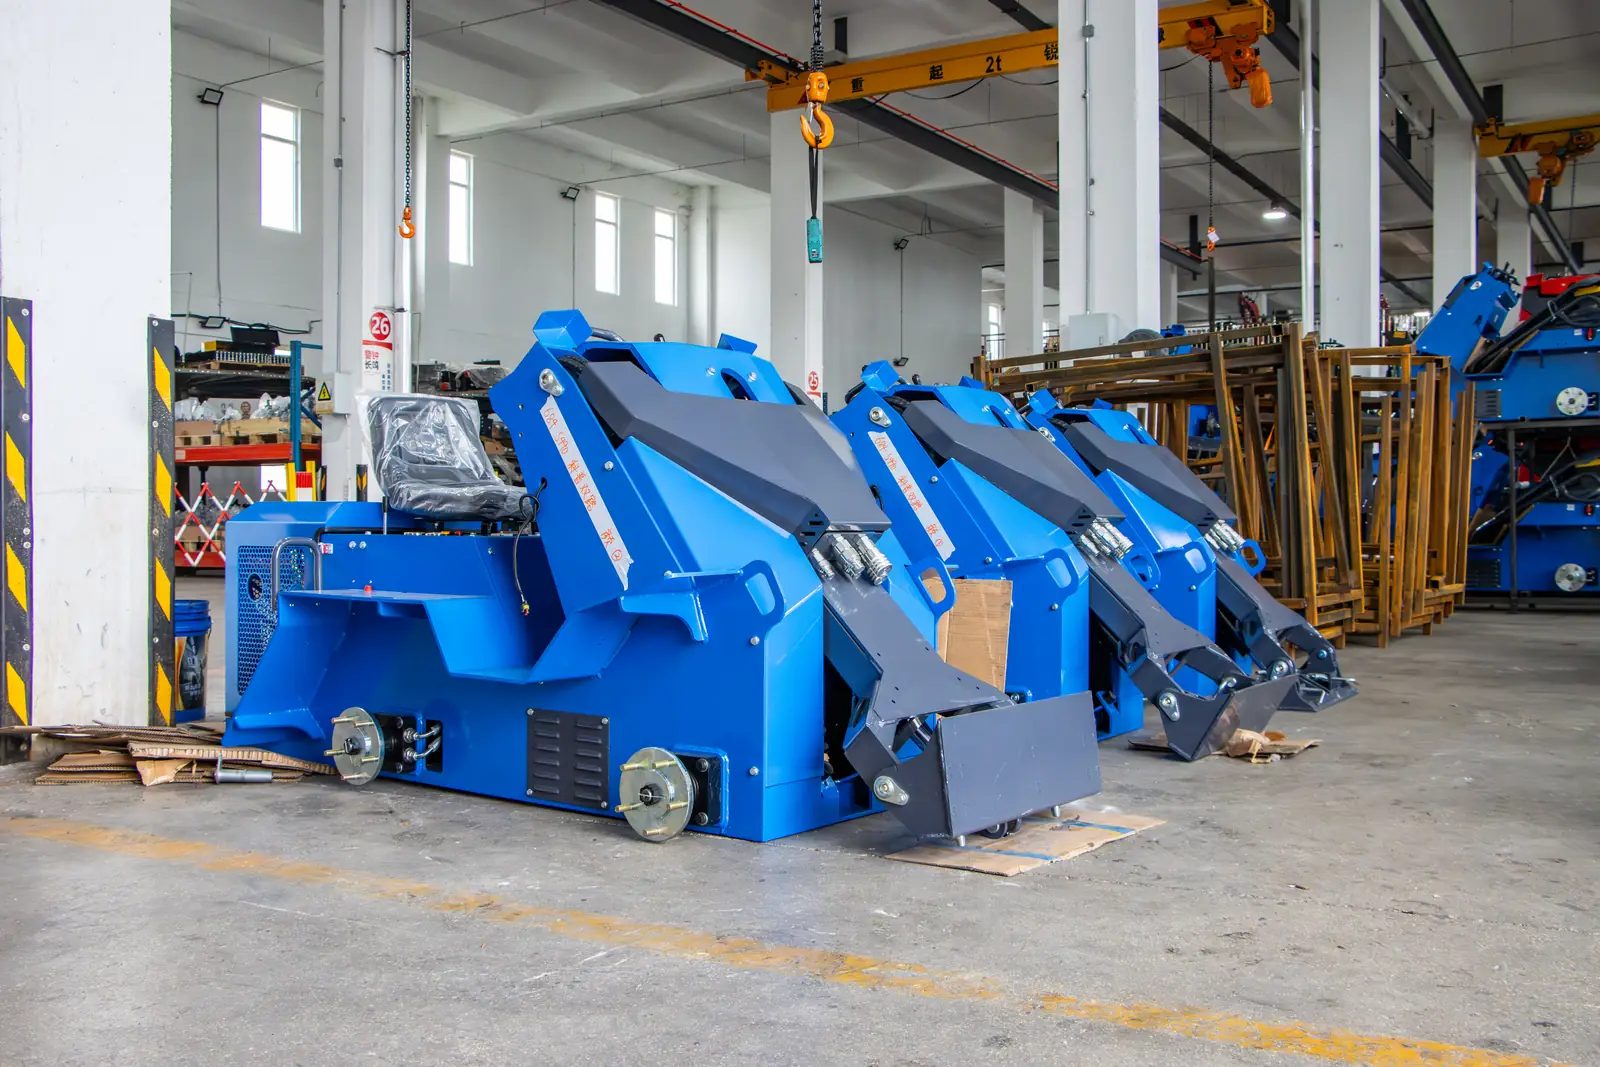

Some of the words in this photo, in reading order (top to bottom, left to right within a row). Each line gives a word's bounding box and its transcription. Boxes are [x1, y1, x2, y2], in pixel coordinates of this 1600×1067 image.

[851, 77, 864, 93] 重
[929, 64, 944, 80] 起
[985, 55, 1002, 73] 2t
[371, 316, 389, 335] 26
[809, 374, 818, 386] 25
